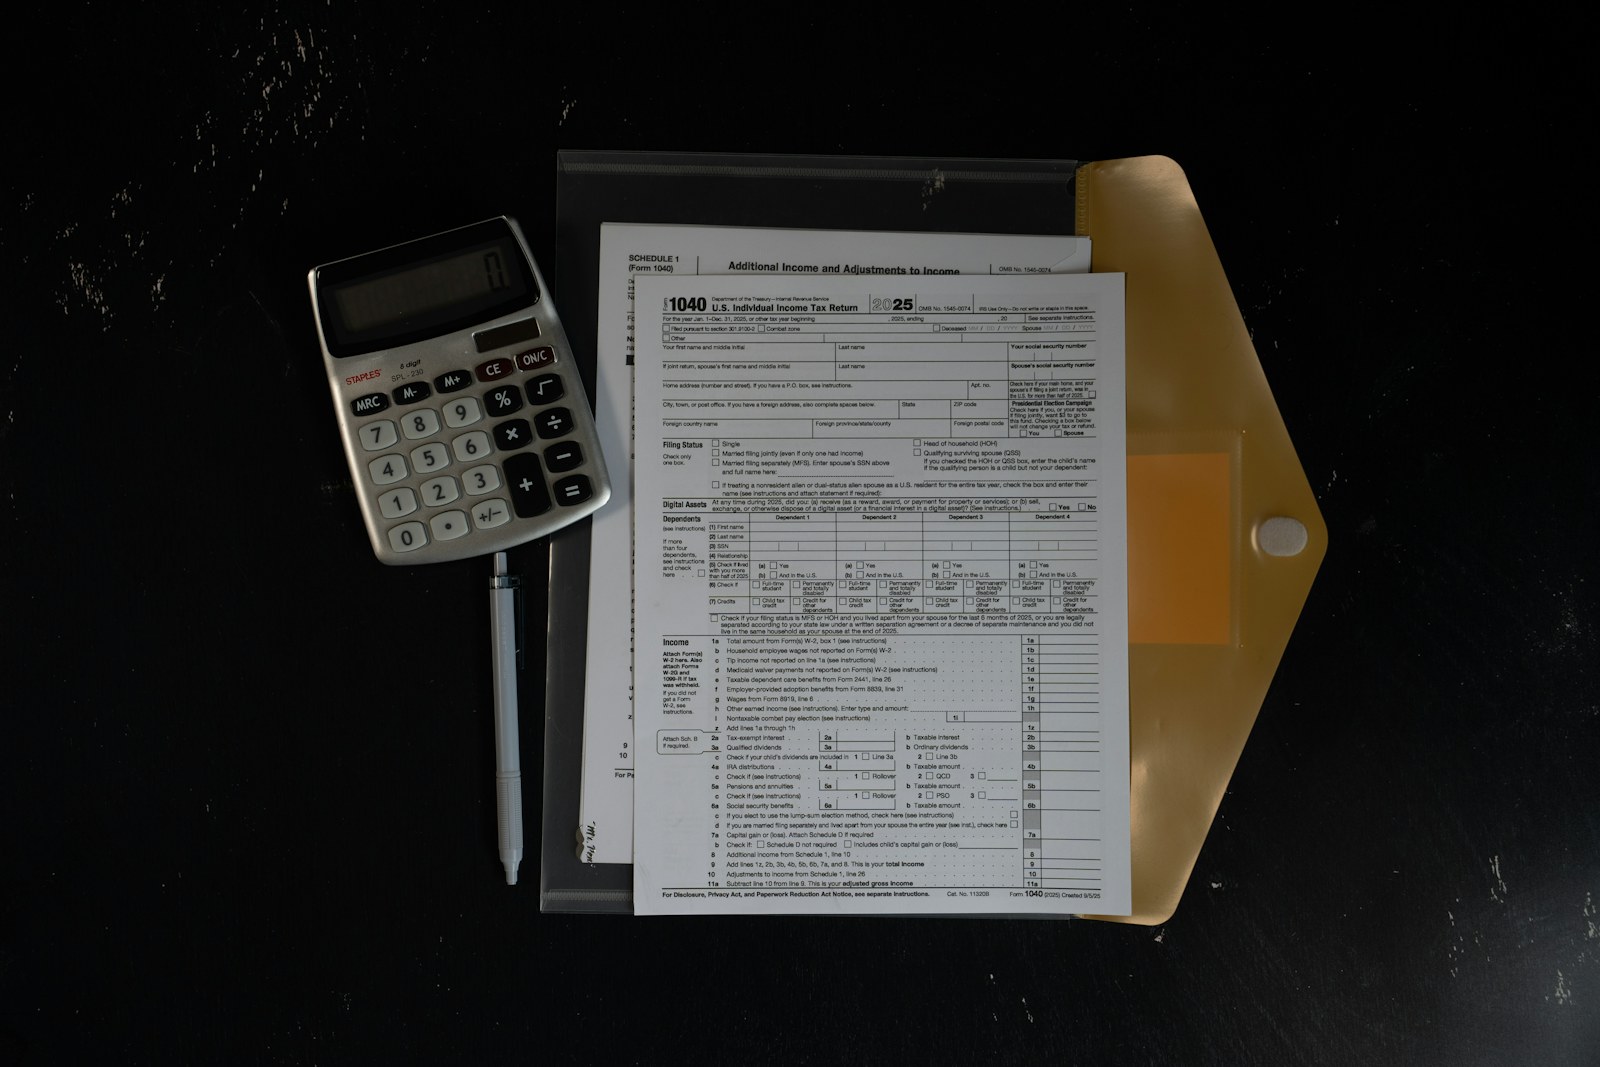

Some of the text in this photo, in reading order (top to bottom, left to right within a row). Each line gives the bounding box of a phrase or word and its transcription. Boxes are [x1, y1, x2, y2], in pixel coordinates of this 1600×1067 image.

[653, 265, 674, 273] 1040)
[728, 261, 779, 271] Additional
[782, 263, 819, 271] Income
[822, 264, 841, 272] and
[842, 264, 905, 274] Adjustments
[669, 297, 707, 311] 1040
[872, 299, 913, 310] 2025
[406, 359, 421, 369] digit
[522, 352, 548, 366] ON/C
[391, 374, 404, 382] SPL
[410, 369, 424, 377] 230
[486, 363, 501, 376] CE
[346, 369, 380, 386] STAPLES
[444, 376, 461, 387] M+
[356, 396, 380, 412] MRC
[495, 392, 511, 408] %
[456, 405, 466, 420] 9
[415, 417, 425, 432] 8
[371, 427, 382, 443] 7
[466, 439, 477, 454] 6
[423, 451, 435, 466] 5
[382, 462, 394, 478] 4
[474, 472, 486, 489] 3
[433, 485, 446, 500] 2
[393, 496, 402, 511] 1
[663, 501, 684, 509] Digital
[401, 530, 413, 546] 0
